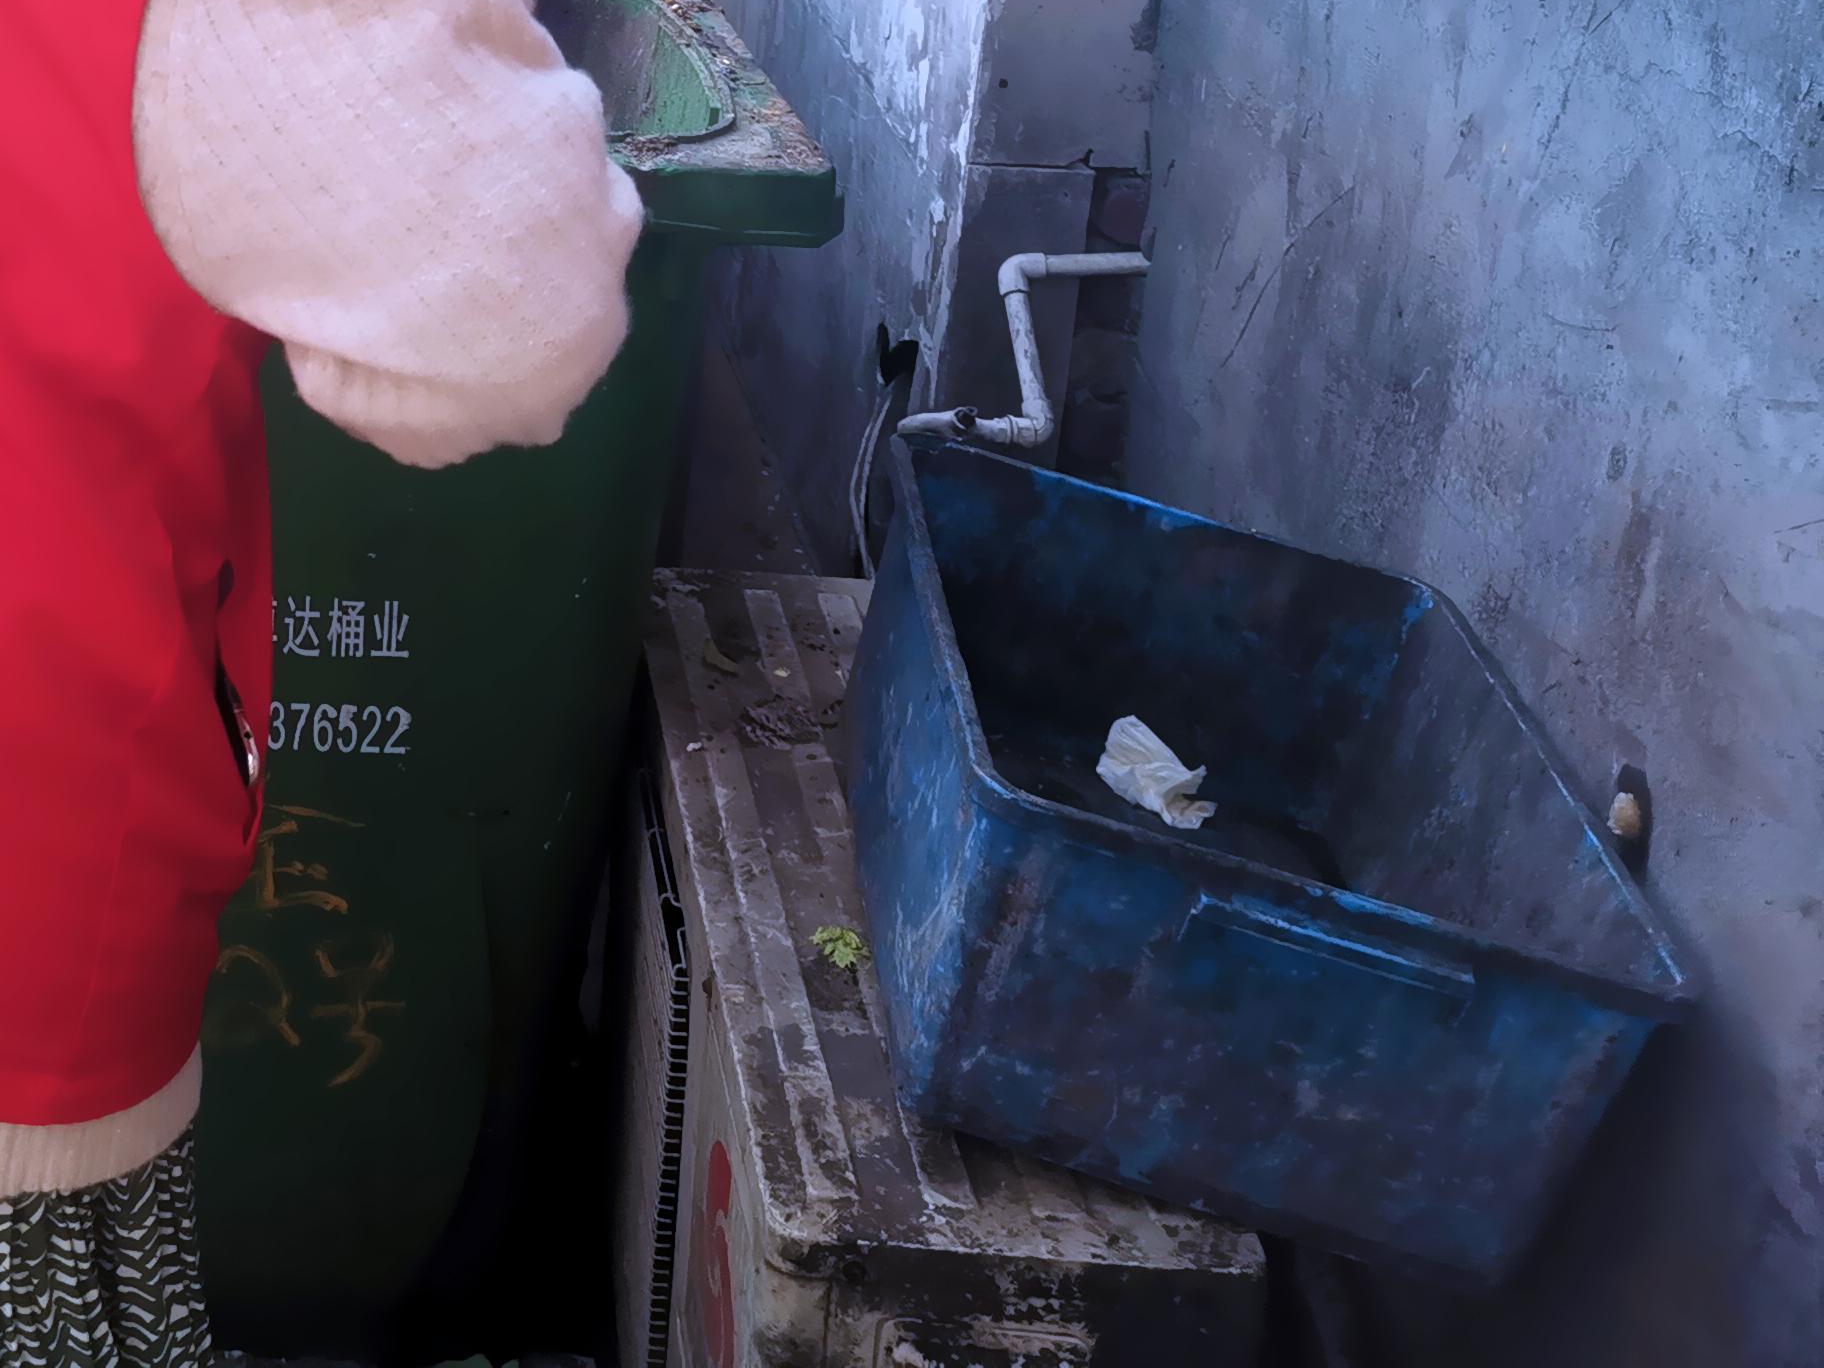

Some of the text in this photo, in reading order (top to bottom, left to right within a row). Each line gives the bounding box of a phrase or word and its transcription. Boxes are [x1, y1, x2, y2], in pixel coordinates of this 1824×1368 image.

[272, 595, 410, 659] 达桶业
[268, 700, 413, 755] 376522
